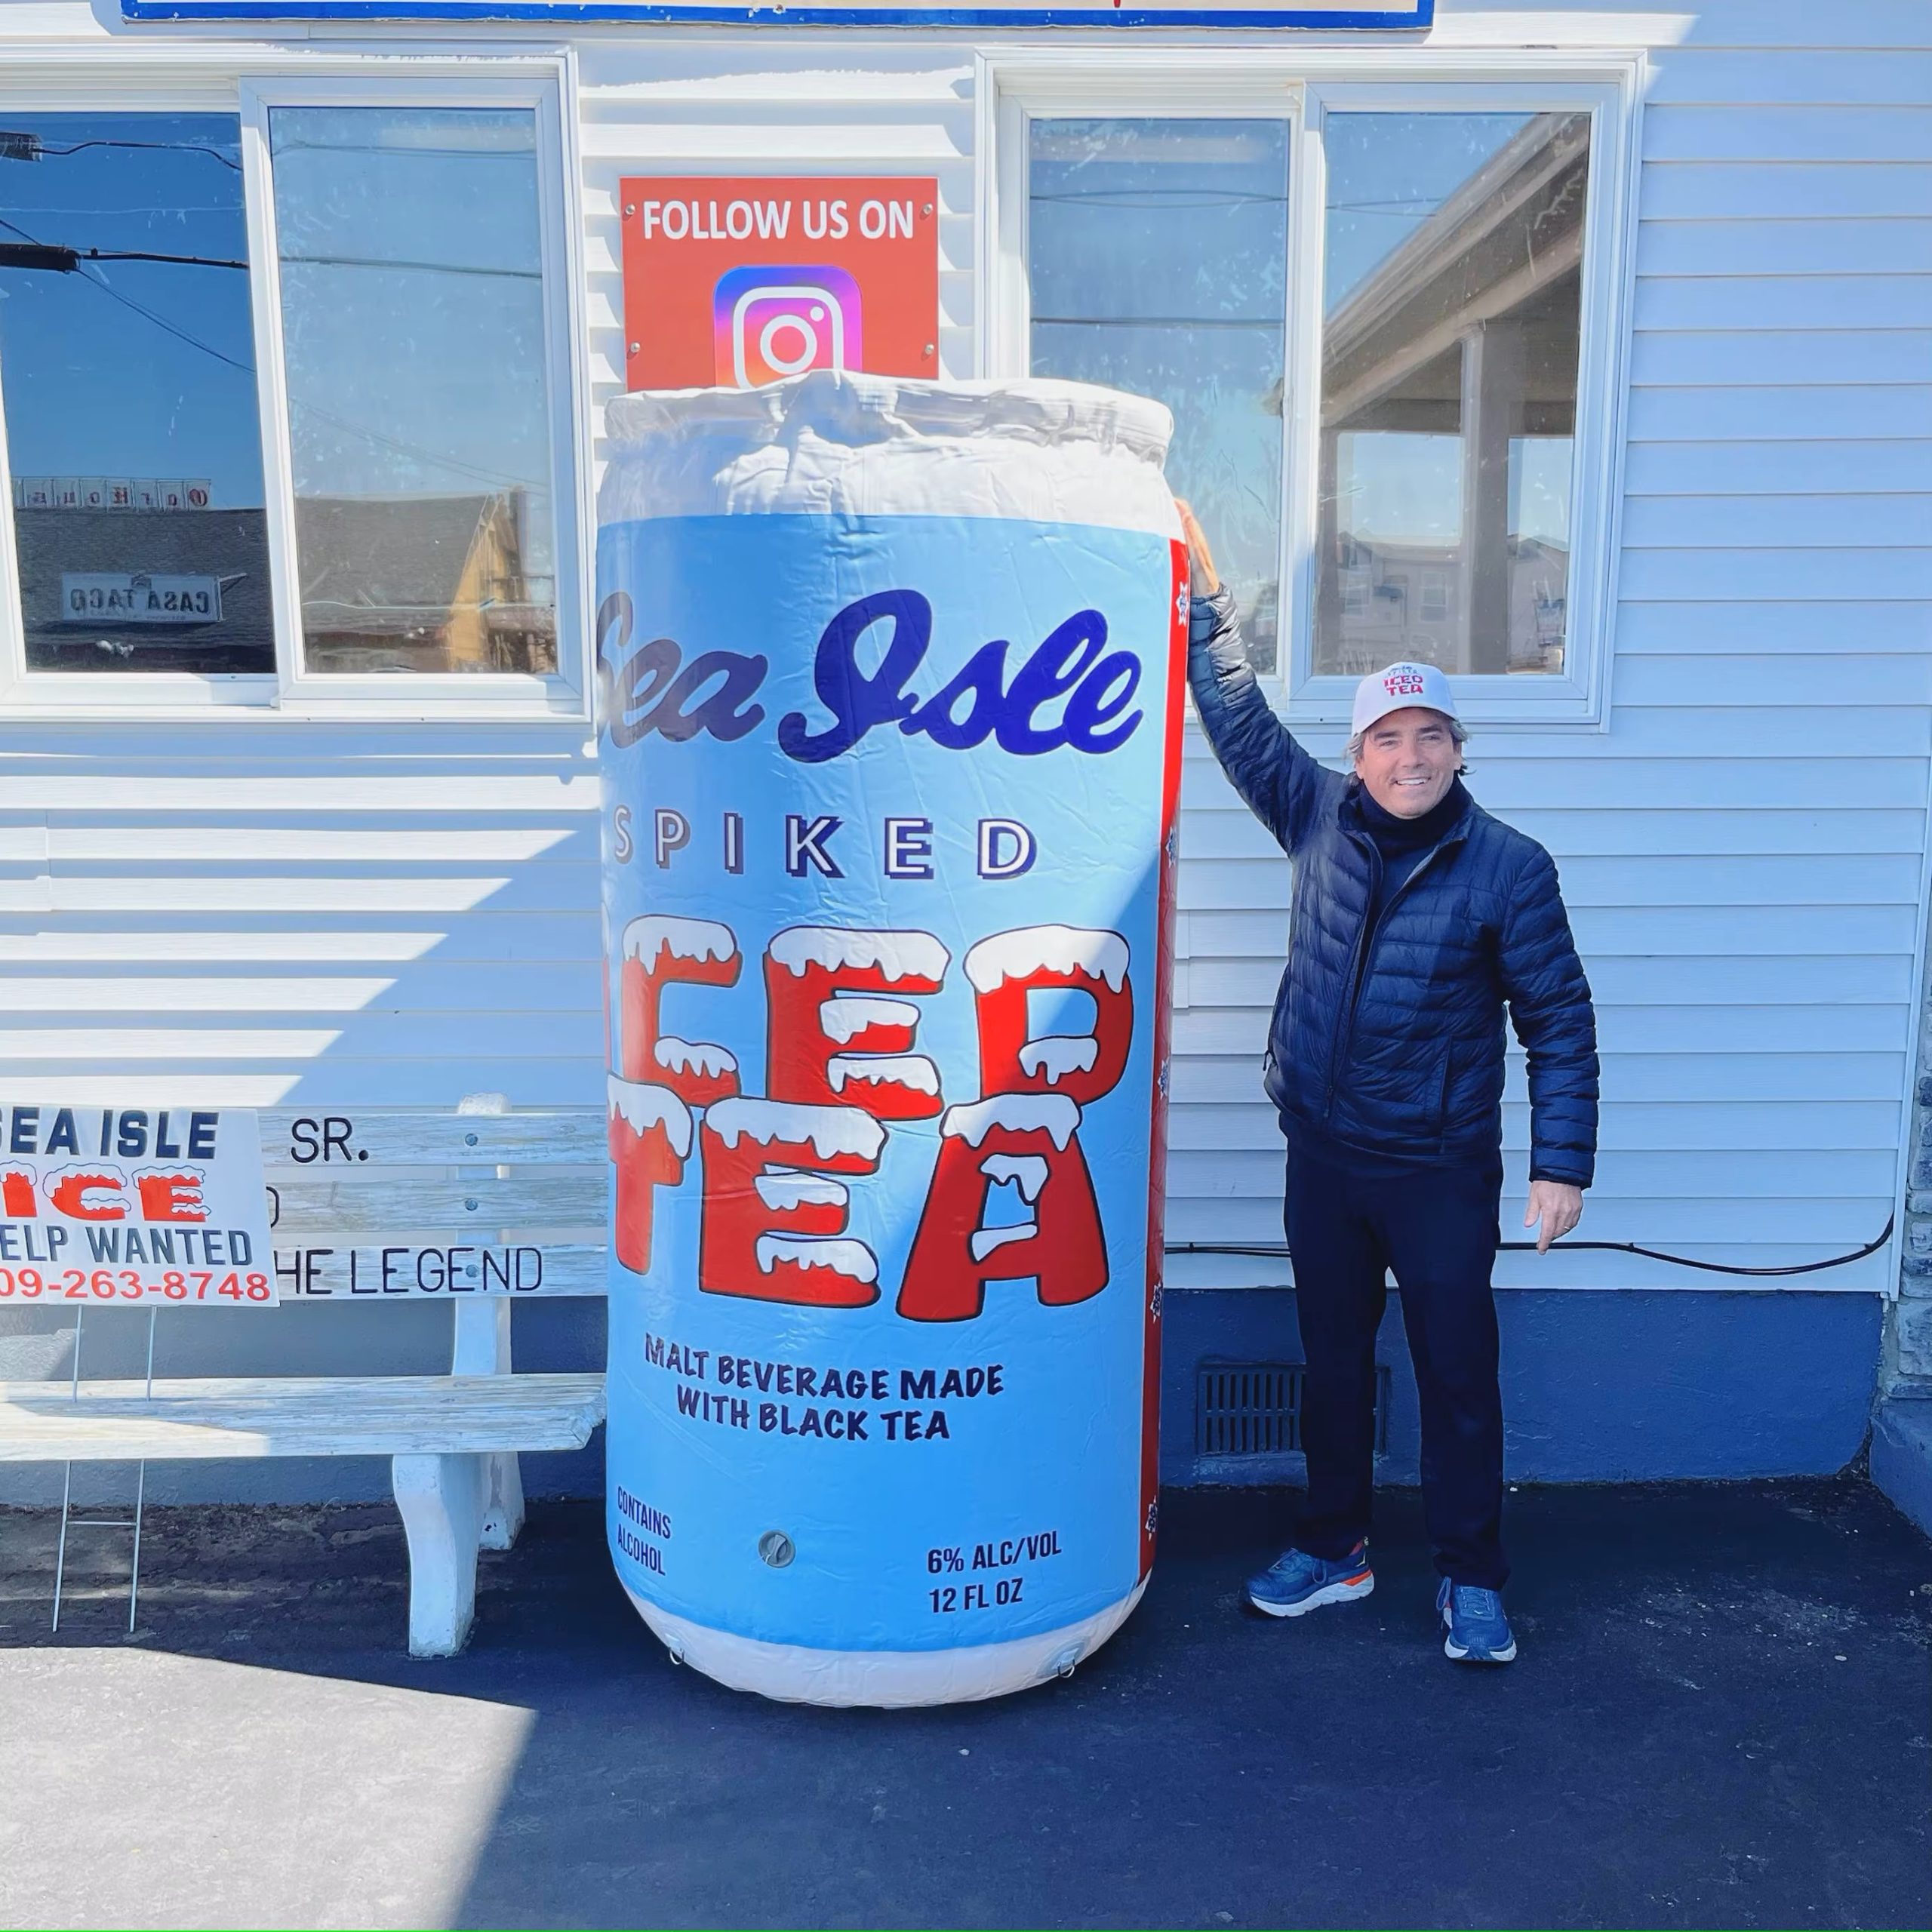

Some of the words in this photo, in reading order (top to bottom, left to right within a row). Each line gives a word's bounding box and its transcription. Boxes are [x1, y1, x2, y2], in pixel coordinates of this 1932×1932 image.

[643, 200, 792, 240] FOLLOW
[803, 200, 849, 239] US
[859, 200, 913, 239] ON
[597, 591, 768, 749] Sea
[777, 589, 1144, 764] Isle
[1383, 675, 1423, 687] ICED
[1386, 684, 1424, 696] TEA
[614, 804, 1038, 881] SPIKED
[603, 915, 1134, 1121] CED
[0, 1106, 81, 1157] EA
[99, 1109, 220, 1160] ISLE
[290, 1117, 369, 1163] SR.
[0, 1161, 212, 1223] ICE
[607, 1070, 1109, 1322] TEA
[85, 1226, 254, 1266] WANTED
[273, 1249, 334, 1295] HE
[350, 1247, 543, 1294] LEGEND
[645, 1333, 709, 1380] MALT
[717, 1355, 891, 1400] BEVERAGE
[899, 1364, 1005, 1399] MADE
[677, 1384, 751, 1431] WITH
[758, 1402, 870, 1441] BLACK
[879, 1410, 951, 1441] TEA
[617, 1485, 672, 1540] CONTAINS
[617, 1523, 666, 1577] ALCOHOL
[927, 1546, 964, 1574] 6%
[971, 1530, 1063, 1571] ALC/VOL
[929, 1587, 957, 1614] 12
[964, 1584, 989, 1611] FL
[995, 1577, 1023, 1605] OZ
